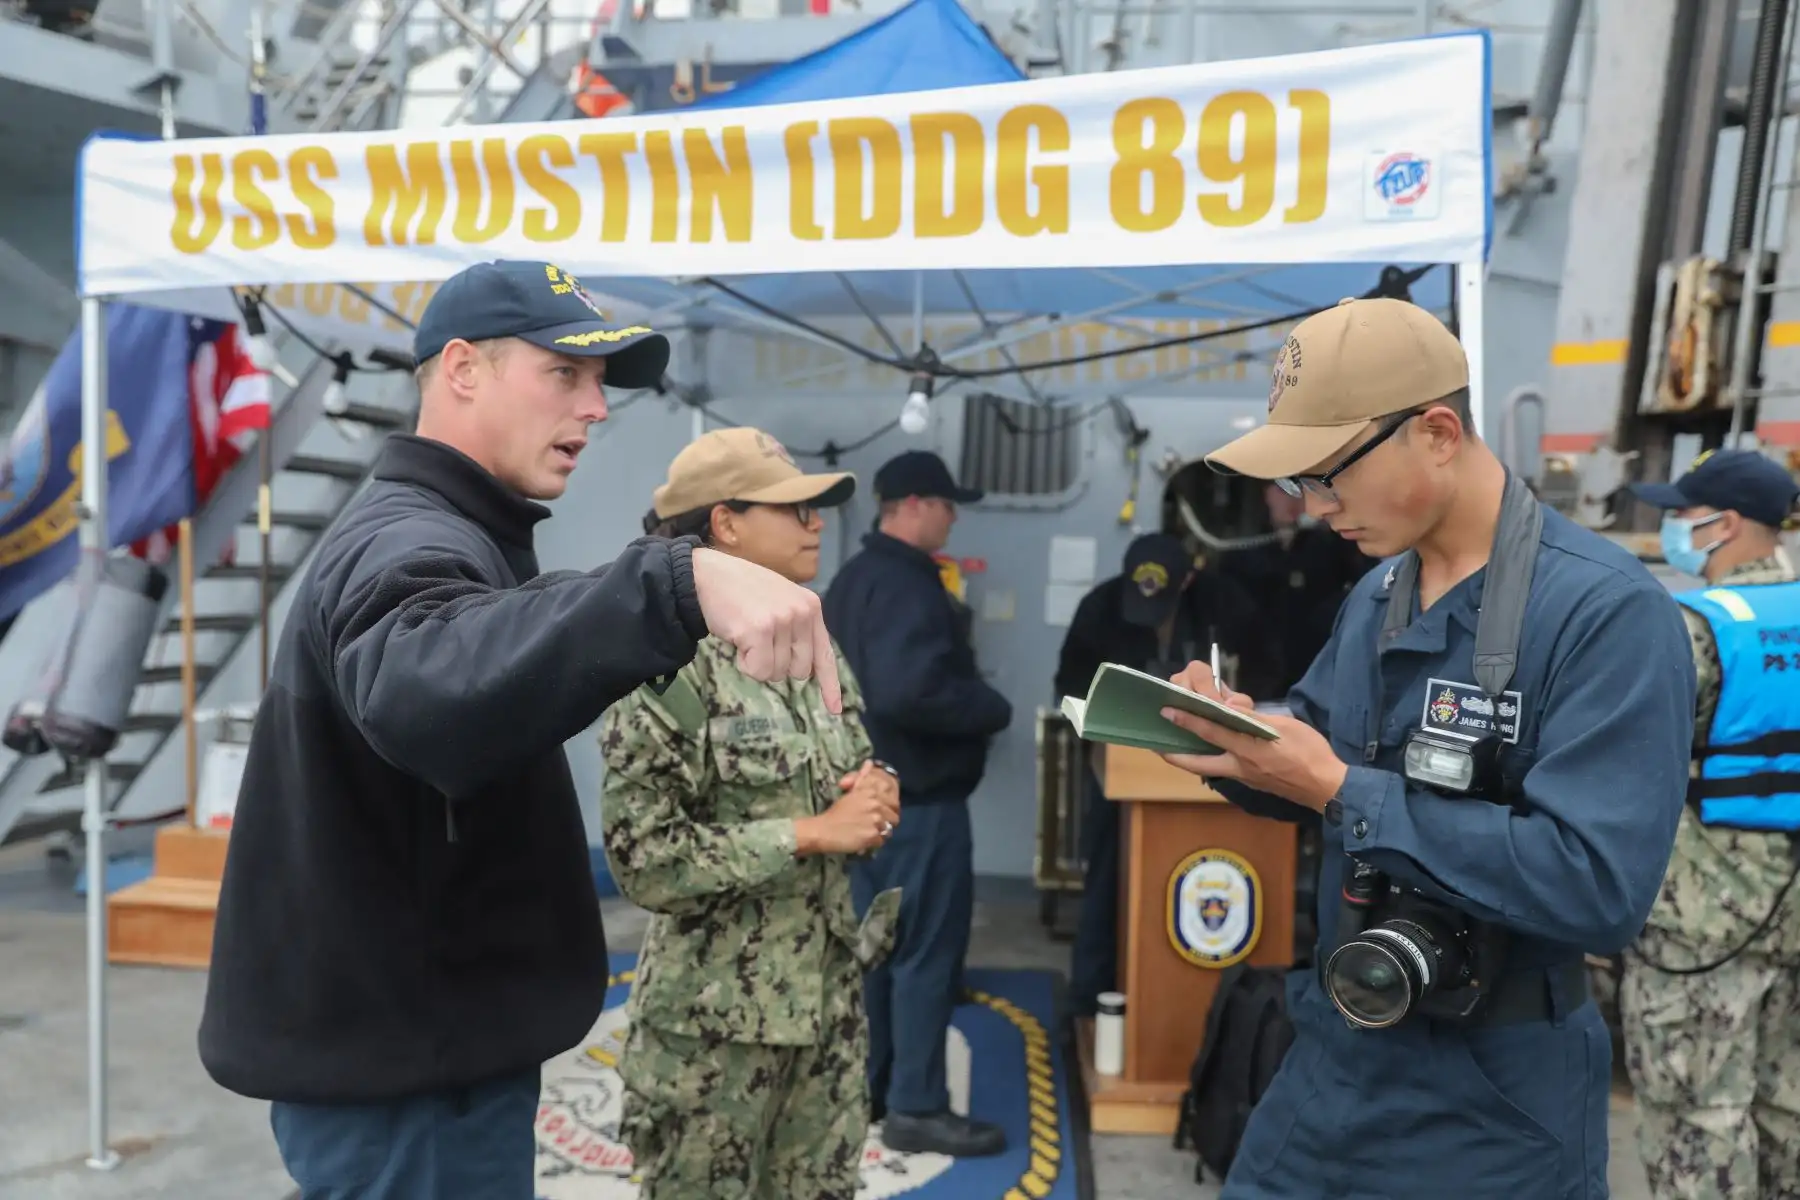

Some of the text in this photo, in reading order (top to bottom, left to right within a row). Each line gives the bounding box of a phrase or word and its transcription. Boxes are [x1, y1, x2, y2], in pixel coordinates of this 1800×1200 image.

[171, 88, 1331, 254] USS MUSTIN (DDG 89)
[1459, 717, 1514, 733] JAMES HNG
